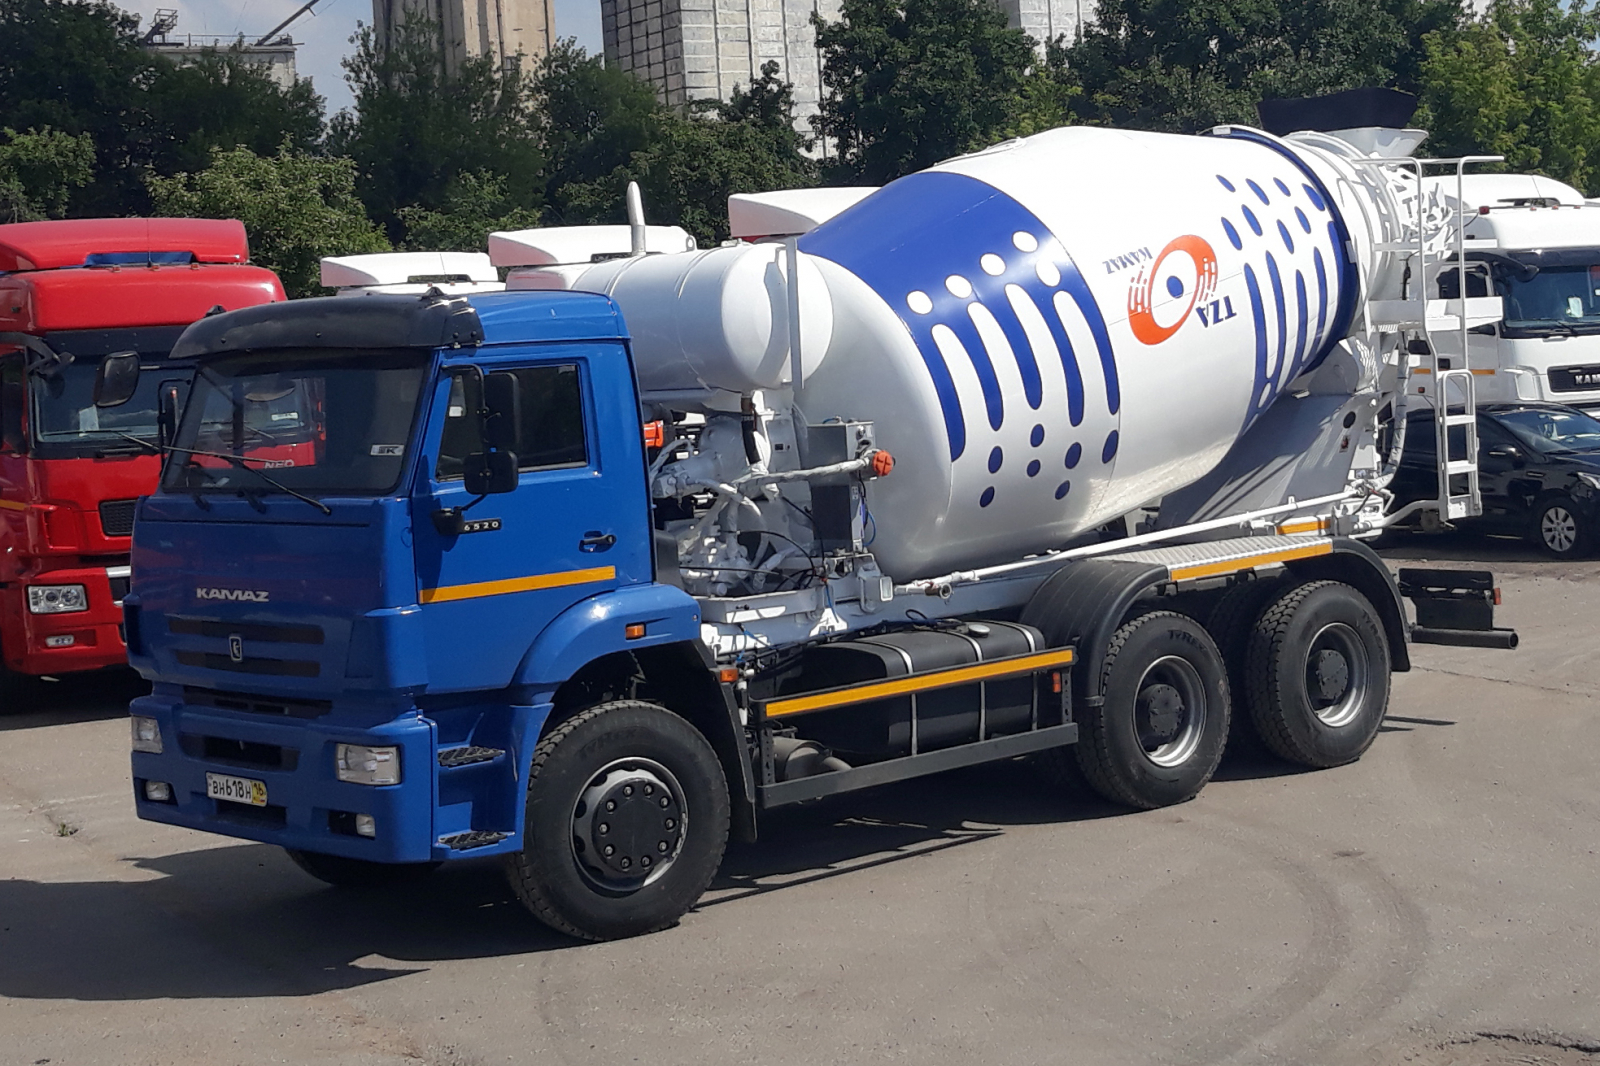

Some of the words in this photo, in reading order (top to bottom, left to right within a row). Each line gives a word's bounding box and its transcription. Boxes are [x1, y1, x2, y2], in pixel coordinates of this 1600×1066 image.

[1102, 247, 1153, 275] KAMAZ
[1195, 295, 1237, 328] TZA
[464, 521, 499, 531] 6520
[196, 587, 269, 602] KAMAZ
